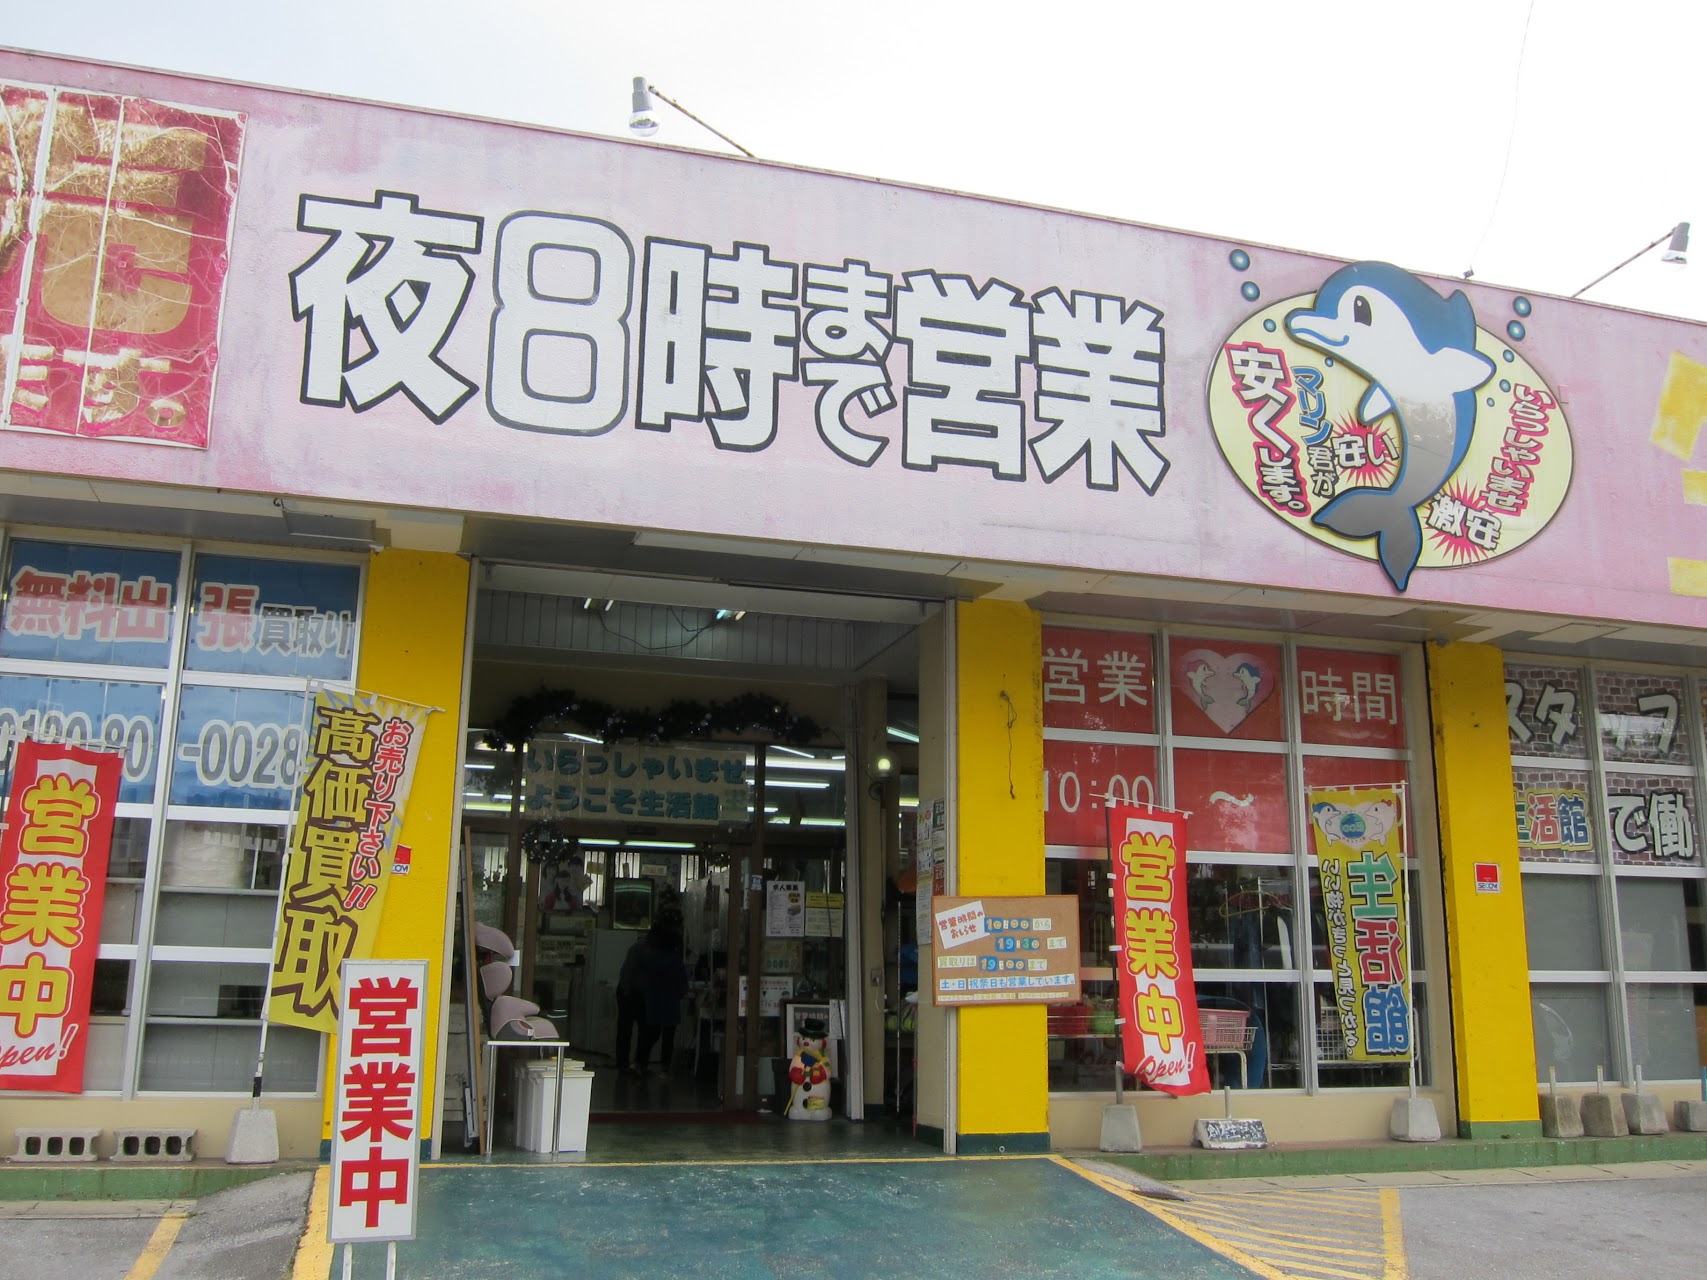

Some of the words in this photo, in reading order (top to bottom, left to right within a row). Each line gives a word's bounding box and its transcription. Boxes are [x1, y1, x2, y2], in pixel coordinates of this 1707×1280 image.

[290, 190, 1170, 495] 夜8時まで営業
[1332, 433, 1400, 470] 安い
[1482, 383, 1557, 515] いらっしゃいませ
[1428, 494, 1501, 550] 激安
[1042, 647, 1149, 707] 営業
[1301, 666, 1398, 726] 時間
[526, 747, 746, 785] いらっしゃいませ
[526, 783, 720, 820] ようこそ生活館
[272, 707, 381, 1018] 高価買取
[1478, 882, 1498, 890] SECOM
[0, 773, 98, 1039] 営業中
[1120, 831, 1184, 1053] 営業中
[0, 1023, 79, 1070] pen!
[339, 977, 418, 1228] 営業中
